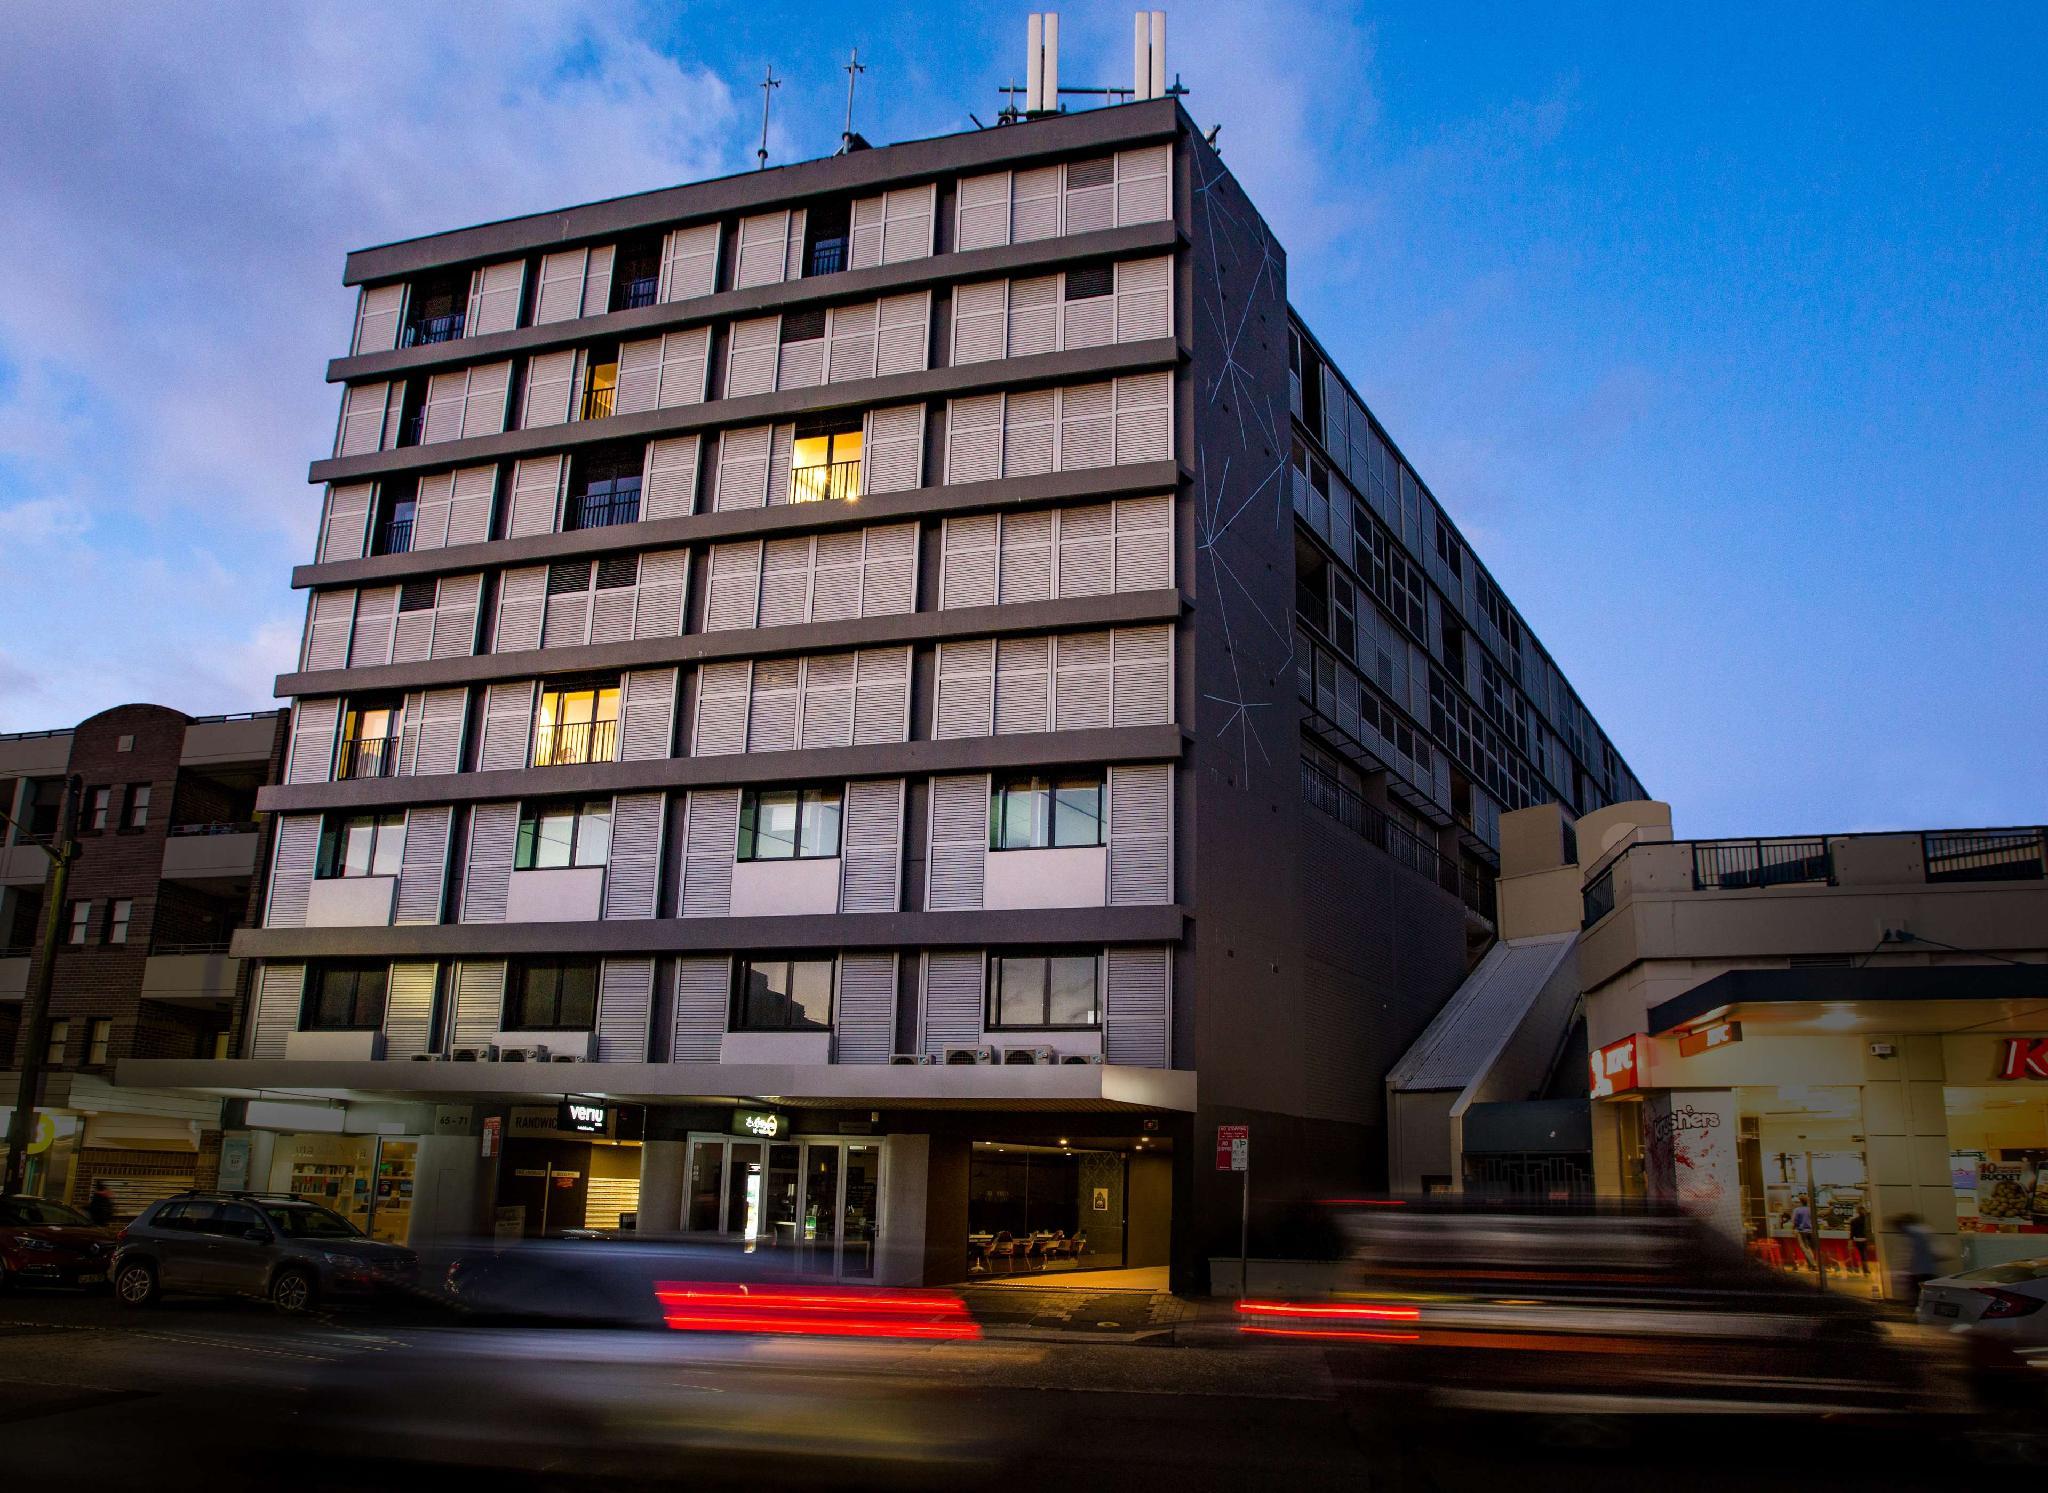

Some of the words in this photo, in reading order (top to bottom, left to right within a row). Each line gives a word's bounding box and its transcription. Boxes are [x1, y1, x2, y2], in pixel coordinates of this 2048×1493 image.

[1606, 1043, 1634, 1076] KFC
[569, 1105, 604, 1123] venu
[515, 1117, 558, 1129] RANDWIC
[1980, 1173, 2021, 1181] BUCKET
